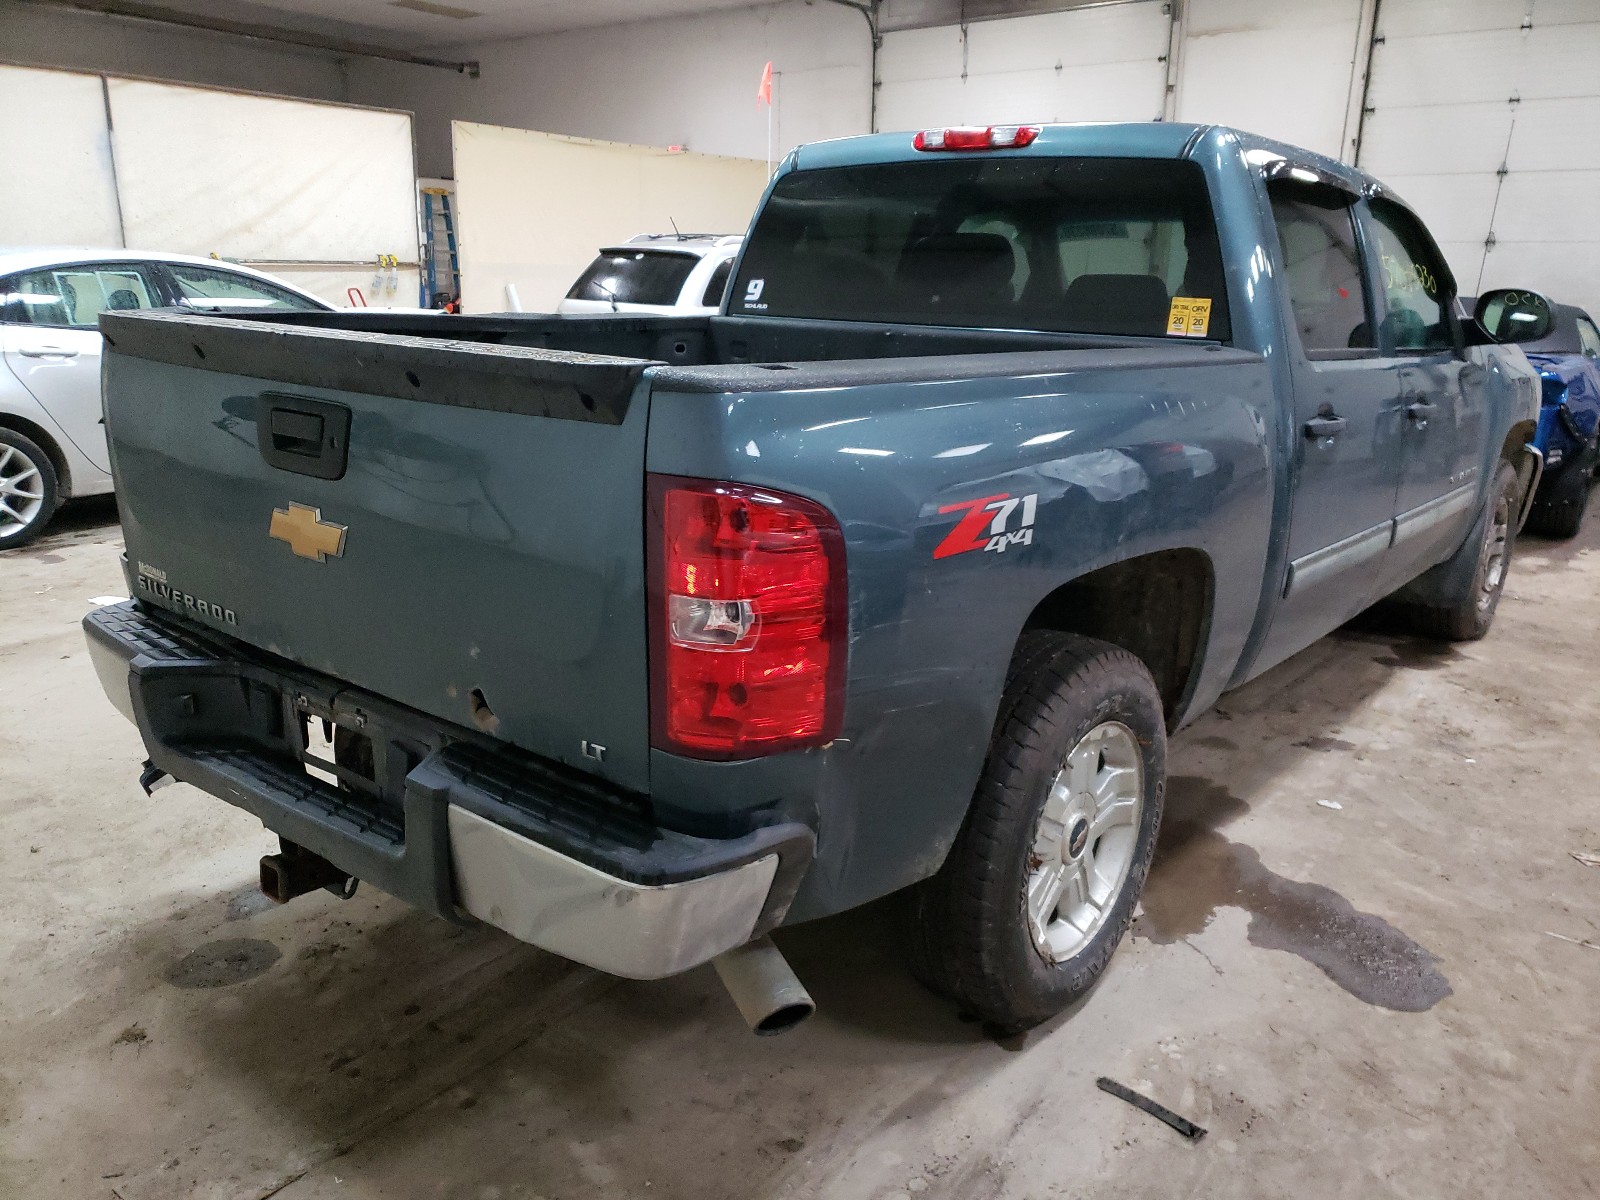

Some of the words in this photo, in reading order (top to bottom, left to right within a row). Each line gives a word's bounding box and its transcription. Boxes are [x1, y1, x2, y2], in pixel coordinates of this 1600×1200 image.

[744, 278, 765, 301] 9
[1173, 316, 1184, 324] 20
[1192, 318, 1203, 326] 20
[932, 492, 1038, 560] Z71
[138, 575, 237, 626] SILVERADO
[581, 740, 607, 762] LT
